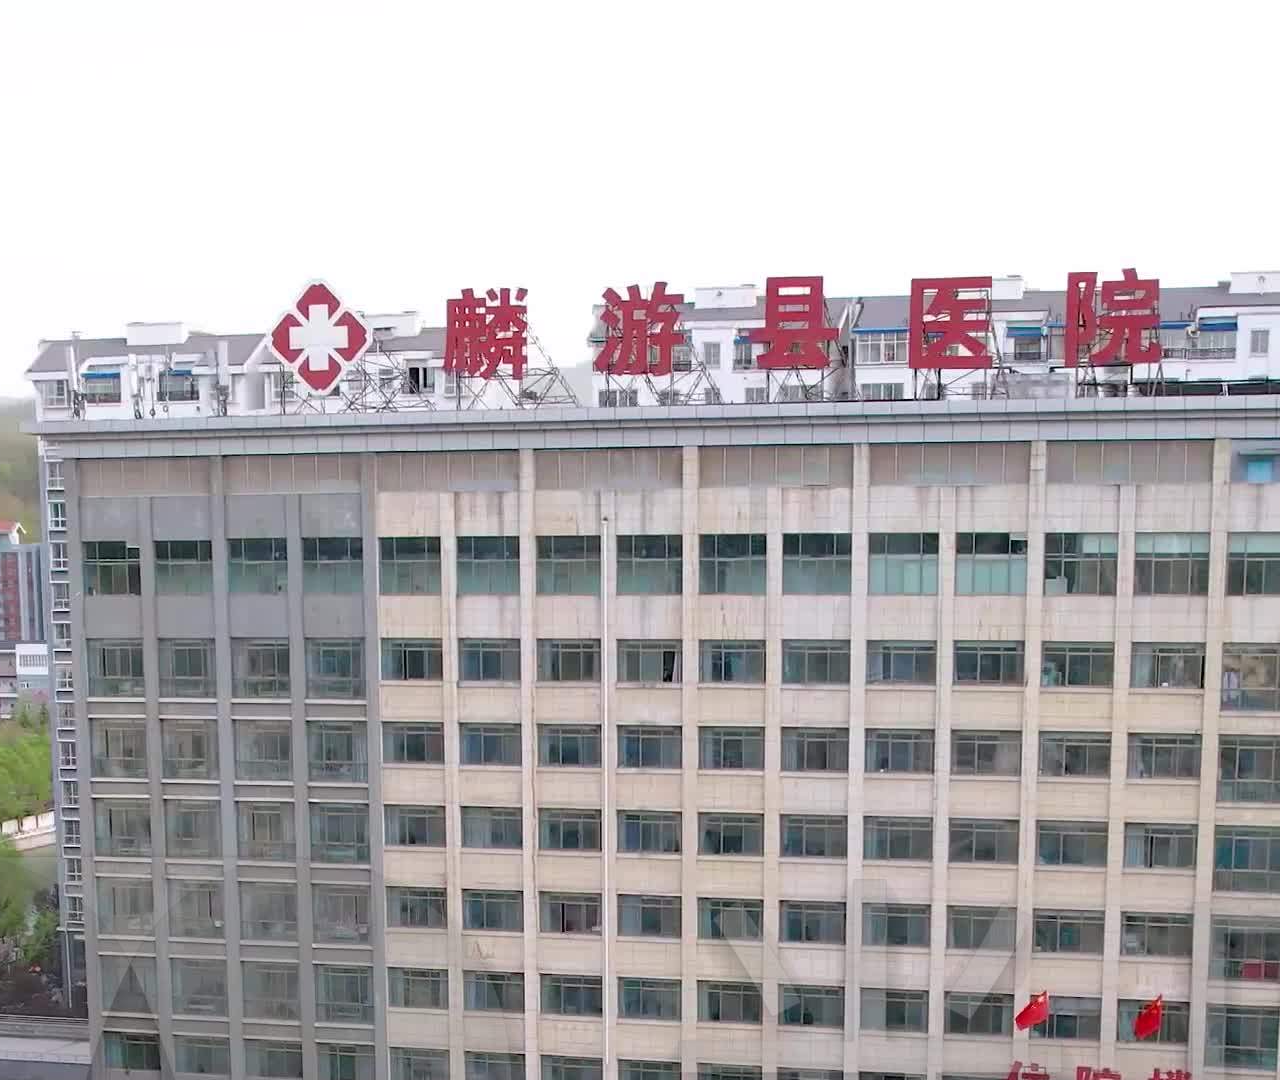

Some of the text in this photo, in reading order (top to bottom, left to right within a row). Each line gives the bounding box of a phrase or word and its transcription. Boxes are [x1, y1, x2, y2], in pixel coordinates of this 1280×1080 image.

[443, 268, 1162, 380] 麟游县医院
